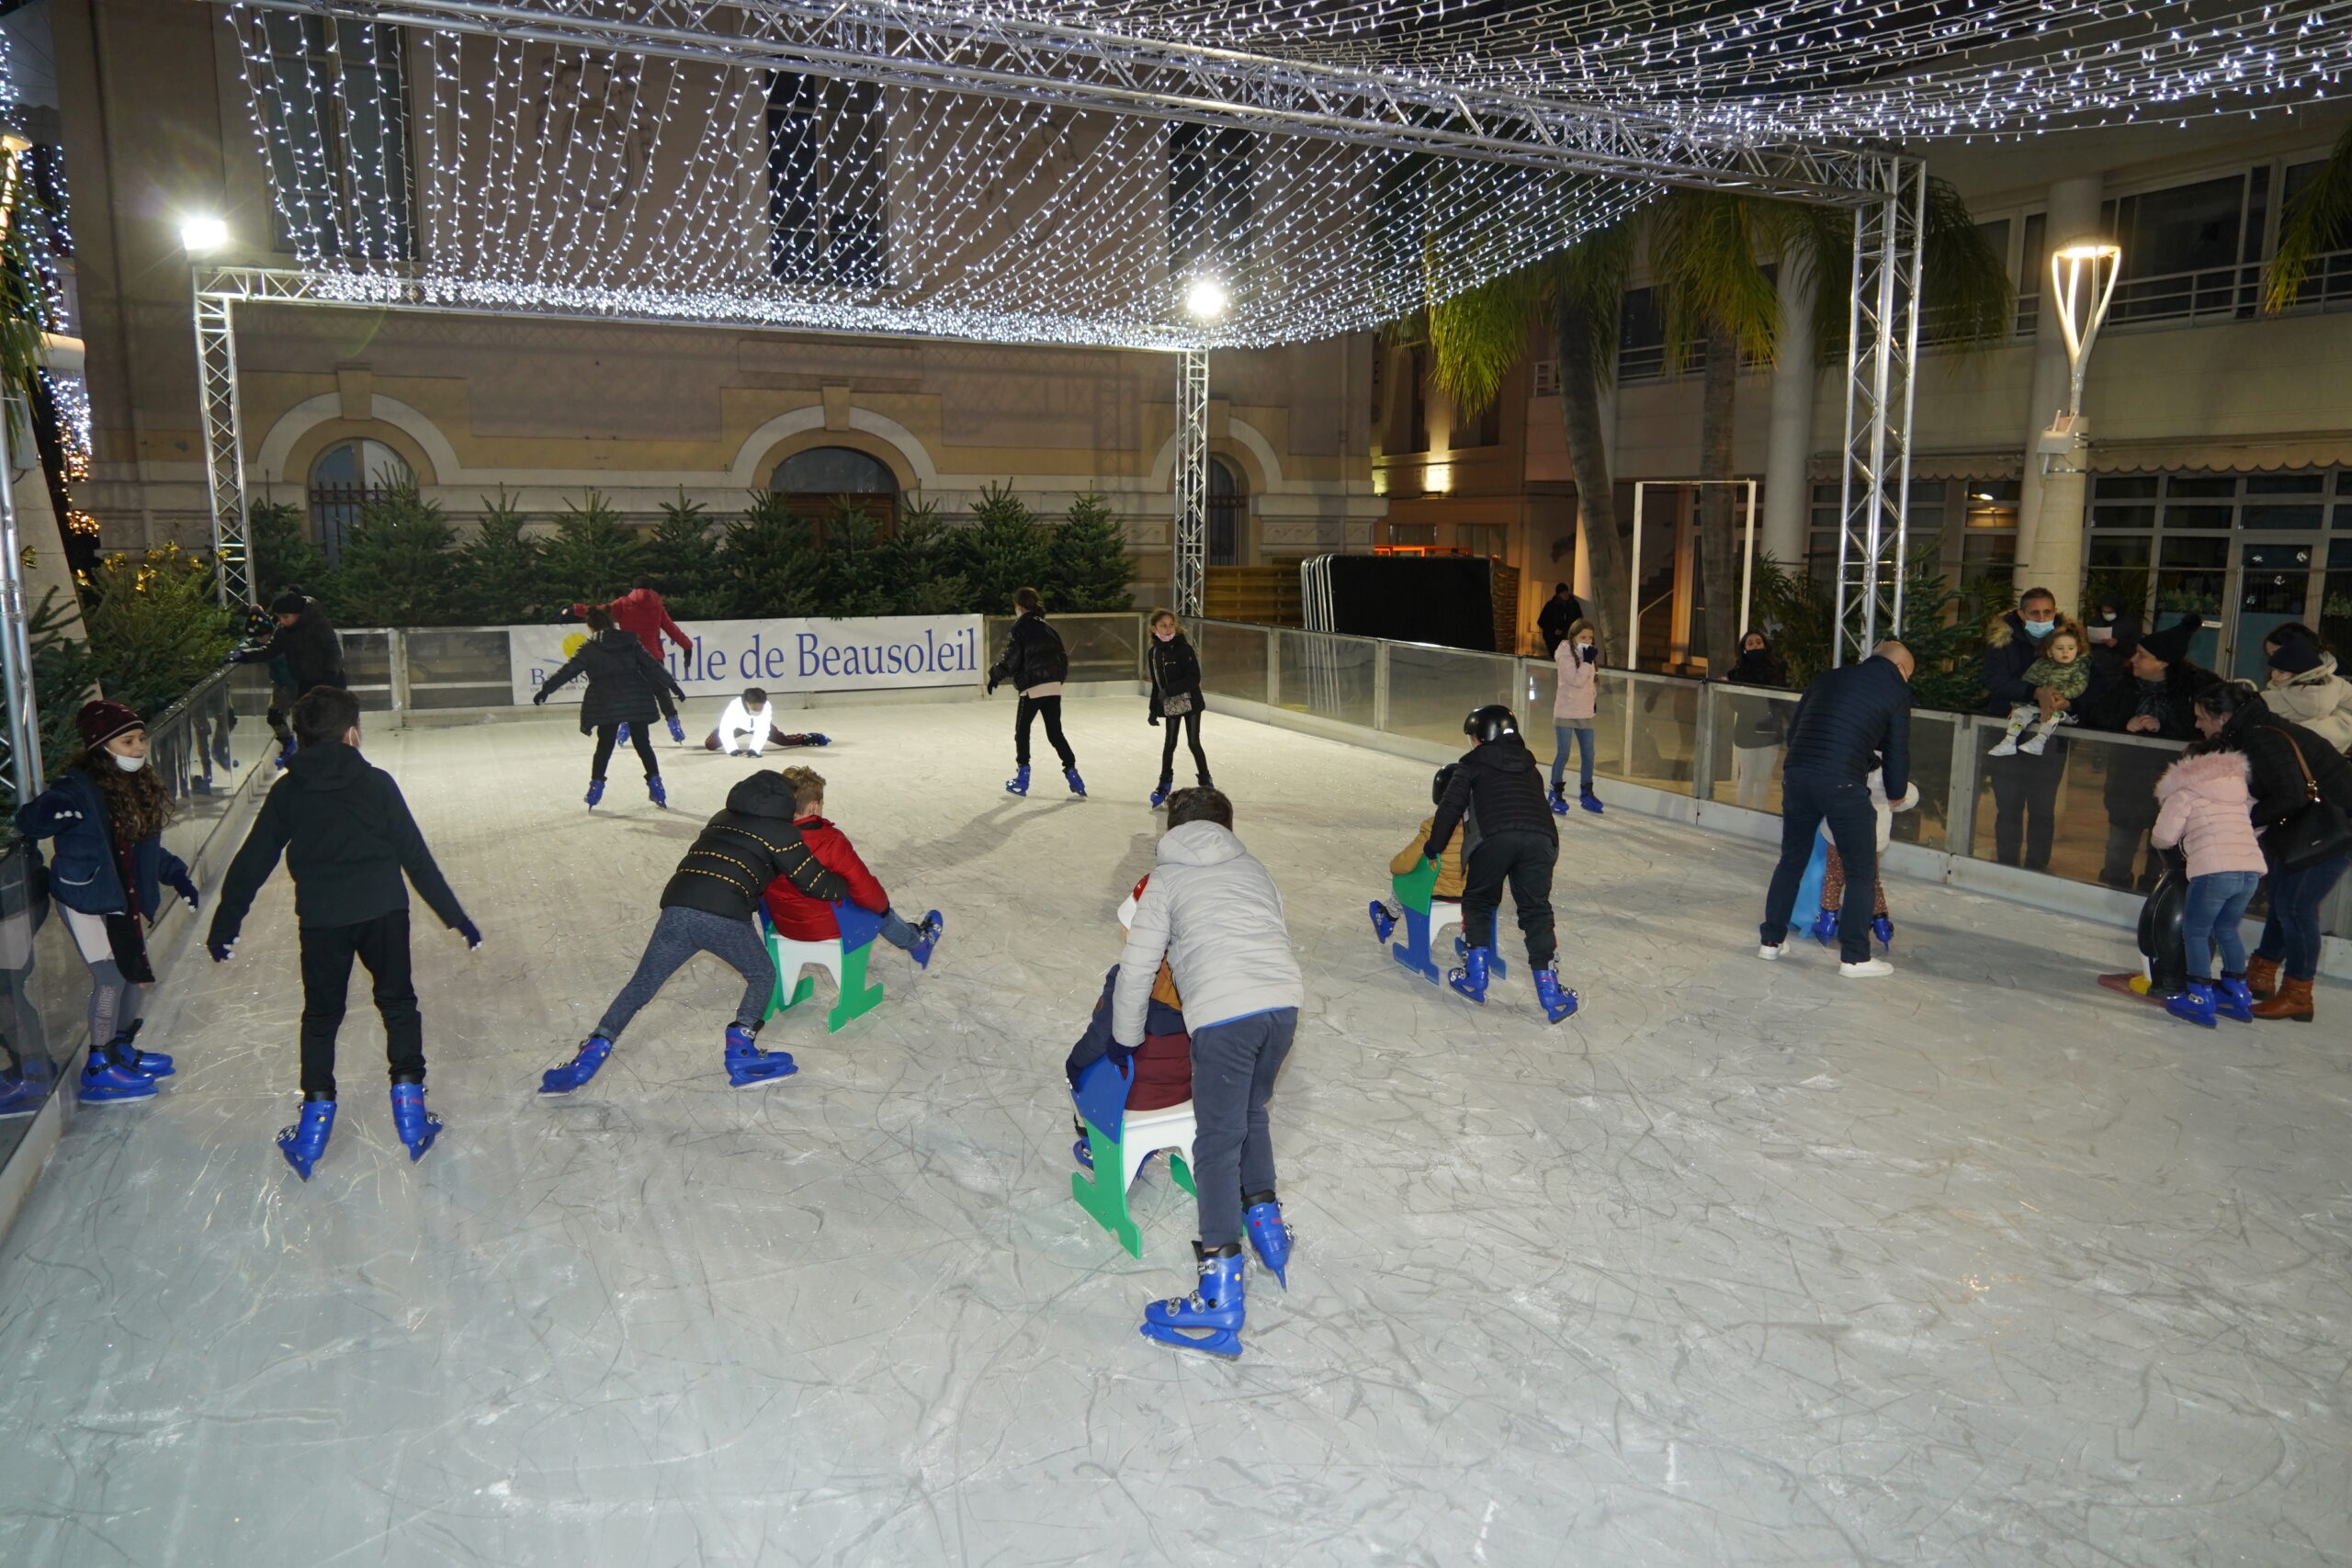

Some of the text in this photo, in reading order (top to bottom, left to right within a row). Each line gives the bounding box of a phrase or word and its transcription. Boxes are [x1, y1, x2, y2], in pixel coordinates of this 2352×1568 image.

[660, 627, 978, 682] ile de Beausoleil
